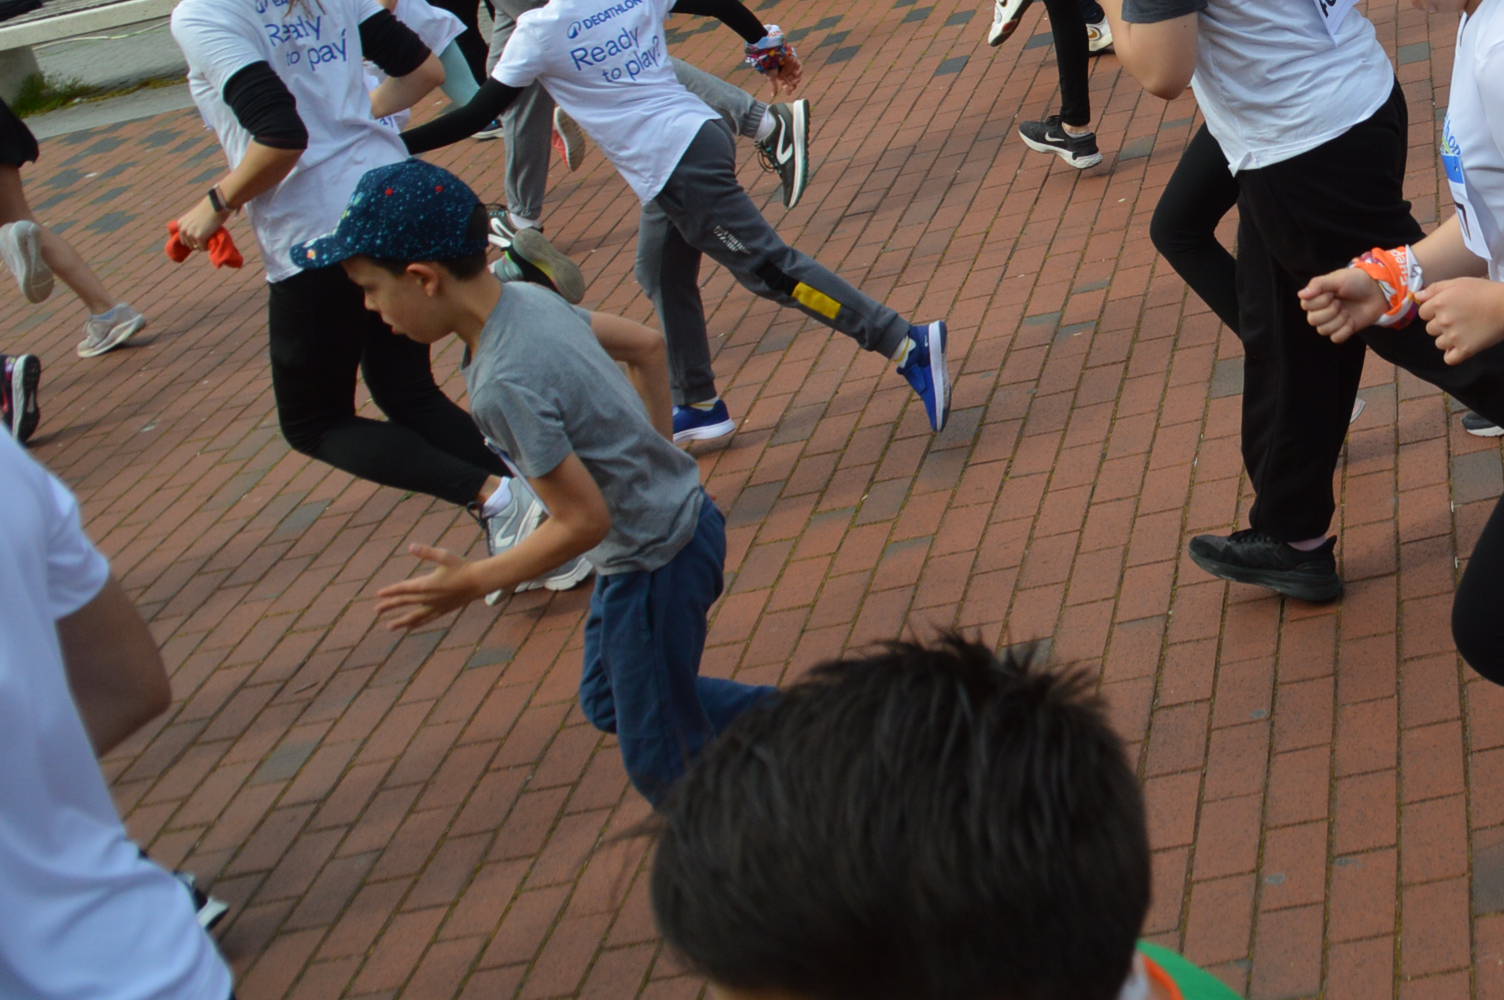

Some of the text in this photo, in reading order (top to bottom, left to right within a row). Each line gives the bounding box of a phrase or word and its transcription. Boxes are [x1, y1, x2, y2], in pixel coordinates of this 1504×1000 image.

[570, 26, 640, 72] Ready
[602, 34, 661, 83] to play?
